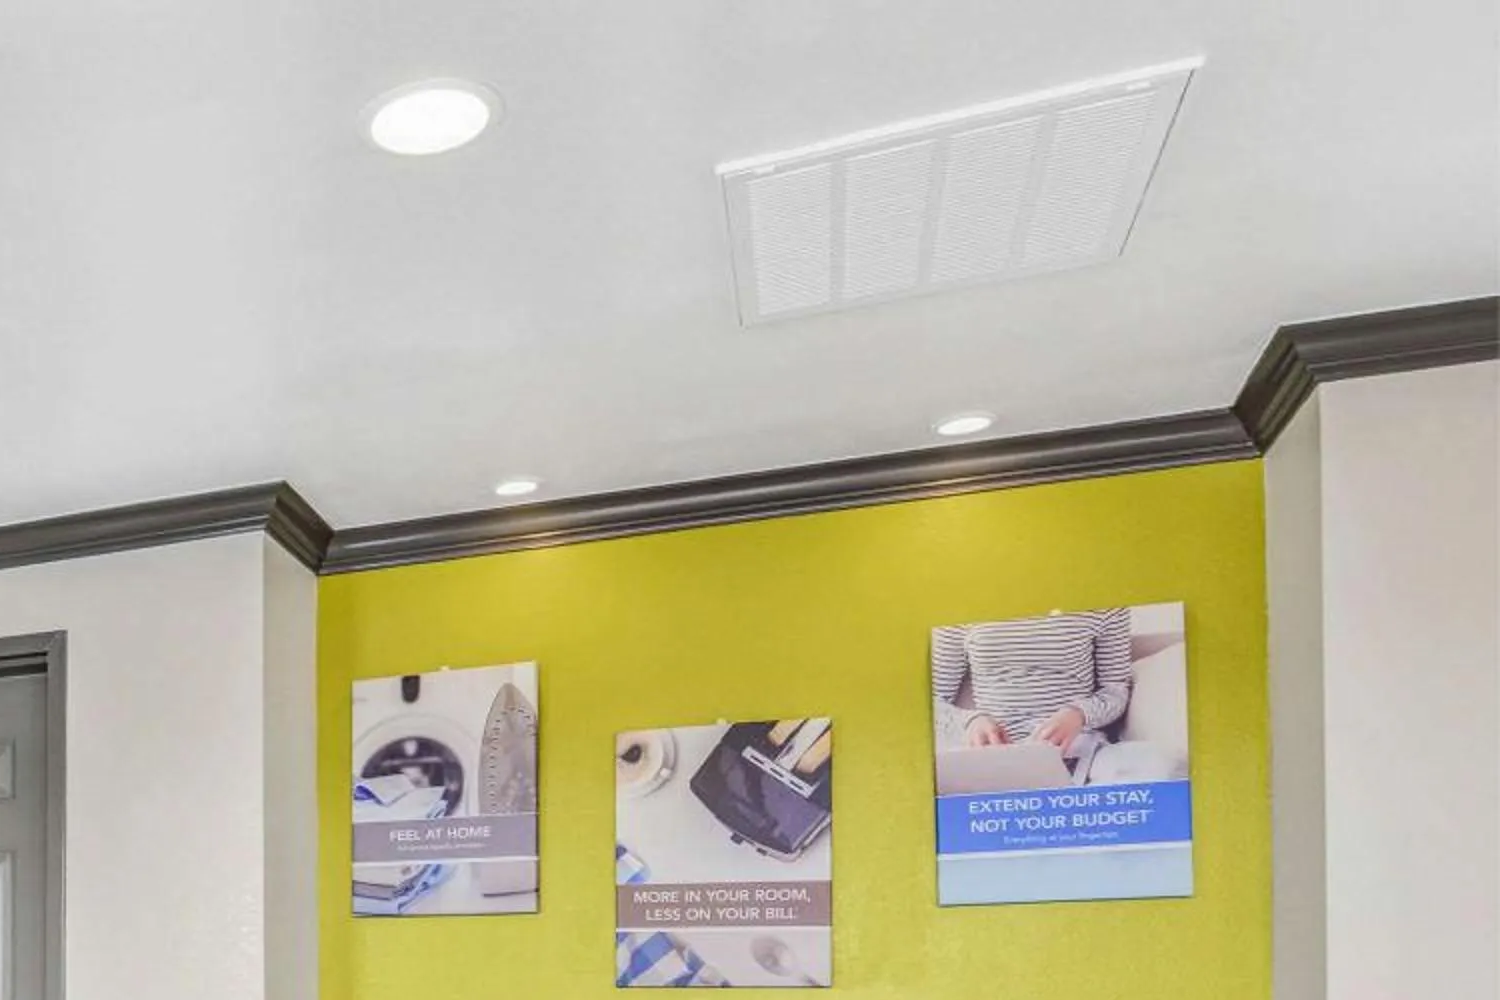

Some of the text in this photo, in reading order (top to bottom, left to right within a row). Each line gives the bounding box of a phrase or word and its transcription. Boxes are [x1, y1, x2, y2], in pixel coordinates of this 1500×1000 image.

[968, 797, 1043, 814] EXTEND
[1048, 793, 1100, 809] YOUR
[970, 818, 1010, 833] NOT
[1014, 815, 1067, 831] YOUR
[389, 825, 492, 842] FEEL AT HOME
[633, 888, 811, 903] MORE IN YOUR ROOM,
[645, 908, 681, 921] LESS
[685, 907, 711, 920] ON
[715, 907, 760, 920] YOUR
